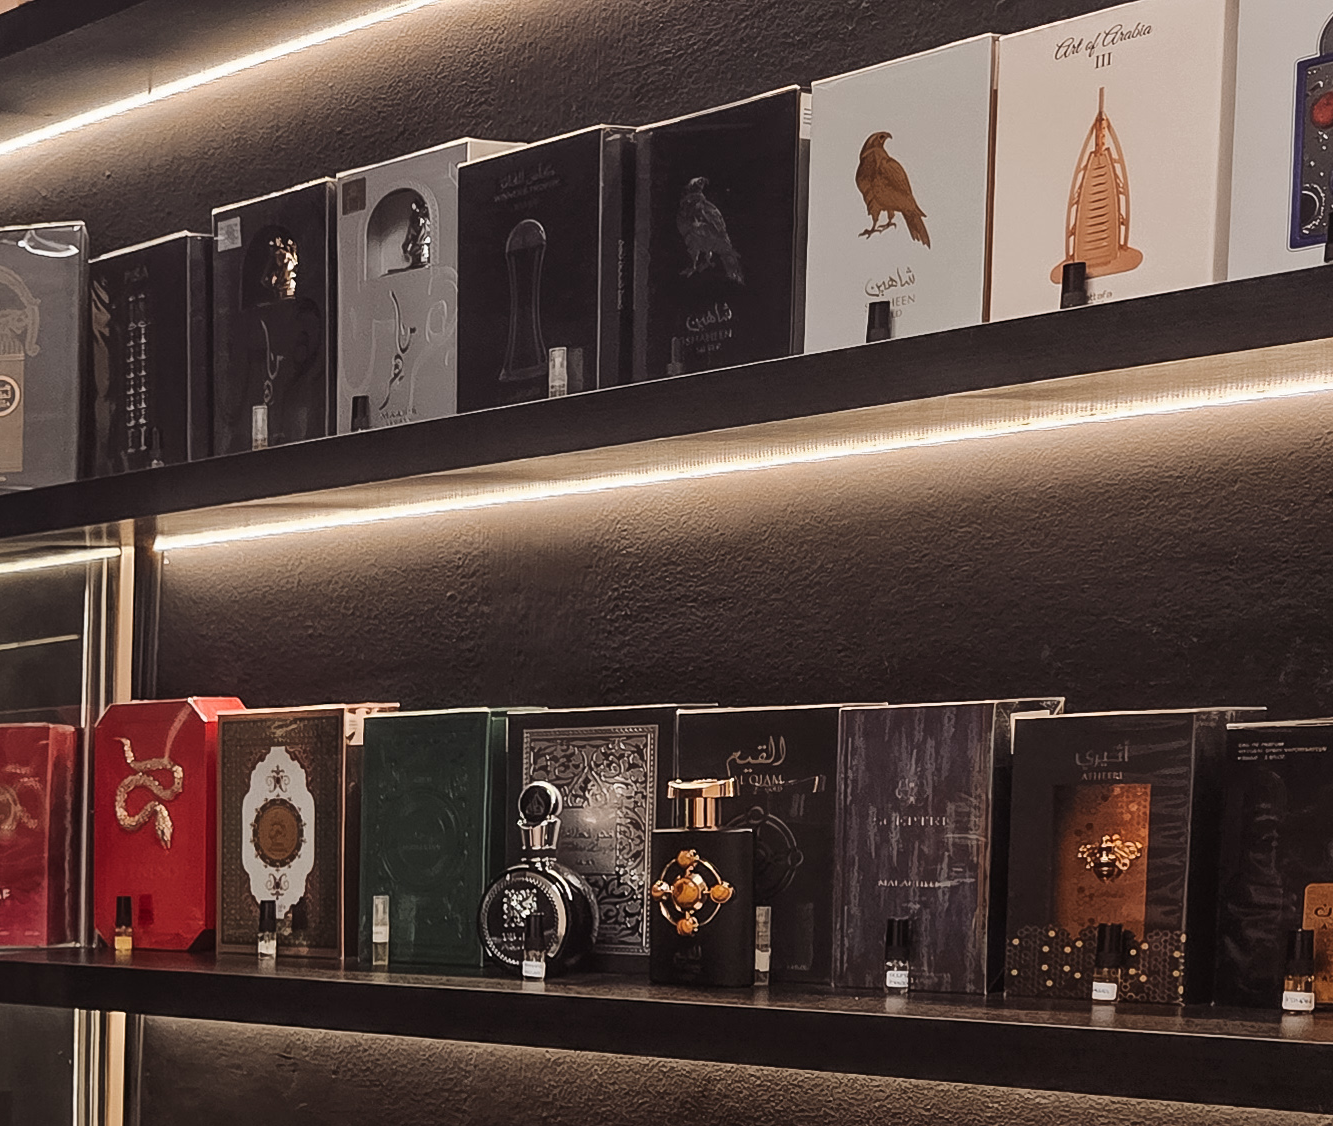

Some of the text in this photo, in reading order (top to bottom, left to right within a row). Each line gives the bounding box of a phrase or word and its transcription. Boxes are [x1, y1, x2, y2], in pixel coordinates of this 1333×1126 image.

[1055, 22, 1153, 60] Art of Arabia
[1095, 52, 1112, 69] III
[864, 266, 915, 297] شاهين
[724, 735, 787, 778] القيم
